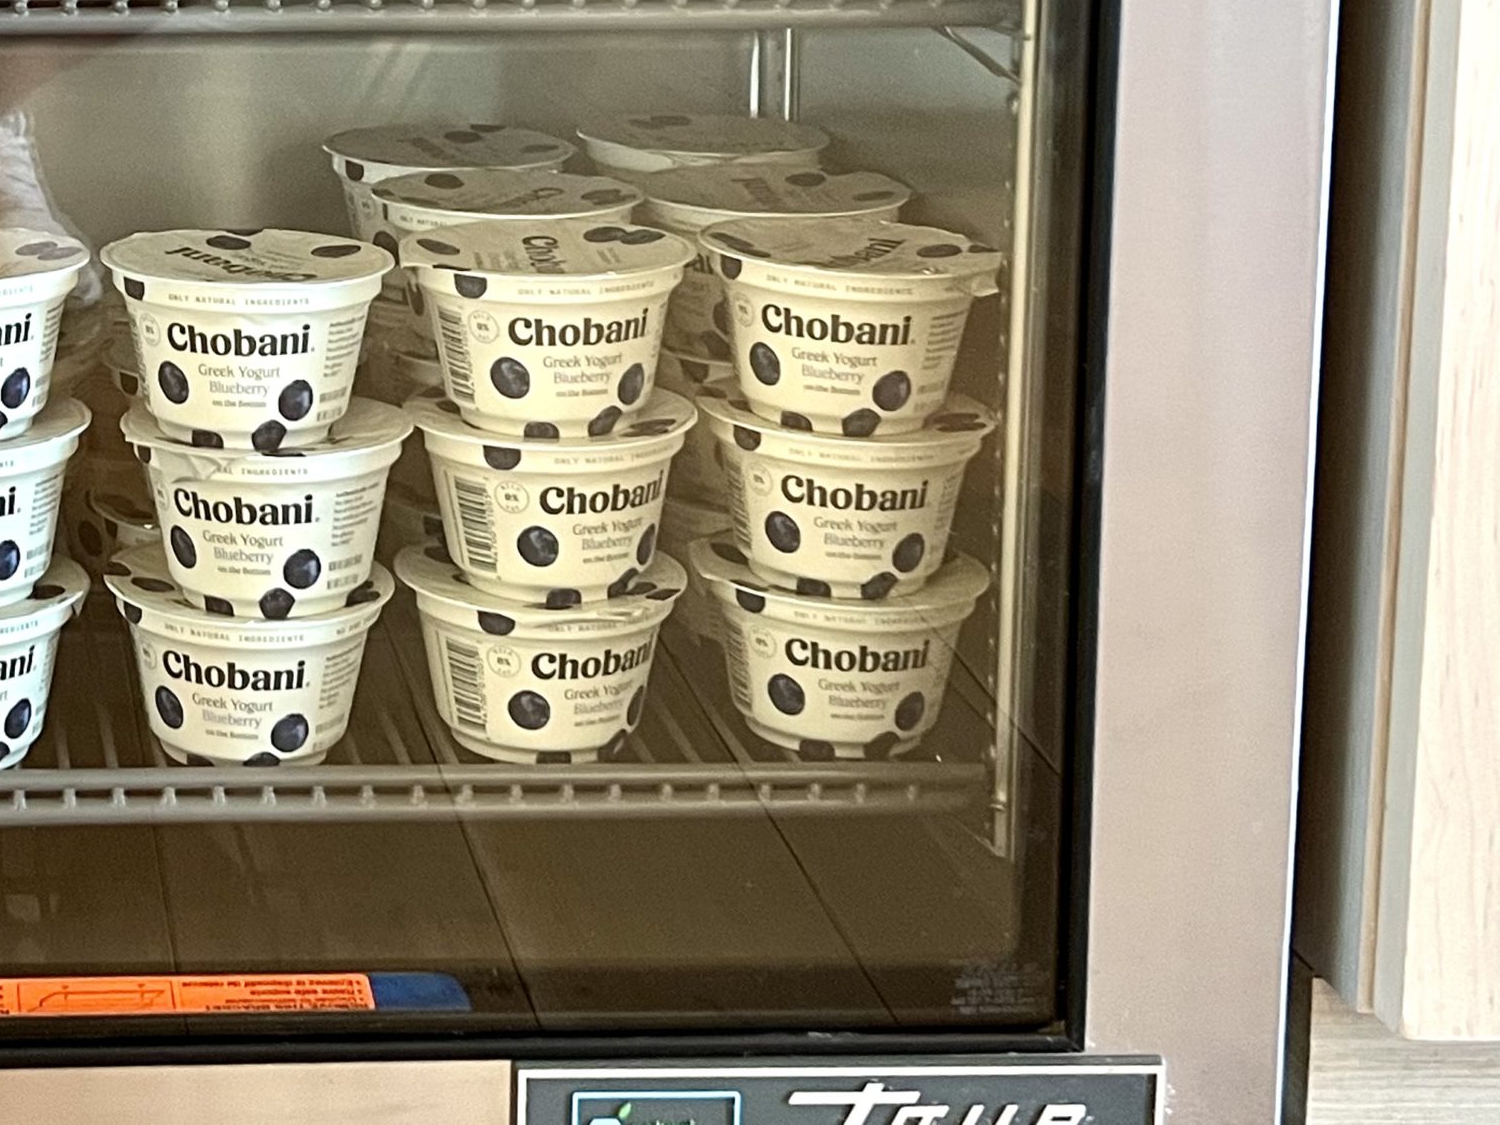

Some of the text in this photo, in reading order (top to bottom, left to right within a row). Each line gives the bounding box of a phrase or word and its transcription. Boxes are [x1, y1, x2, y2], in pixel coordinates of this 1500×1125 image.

[508, 308, 648, 346] Chobani
[762, 304, 912, 346] Chobani
[167, 323, 310, 356] Chobani
[543, 353, 623, 367] Greek Yogurt
[792, 347, 877, 367] Greek Yogurt
[198, 364, 280, 380] Greek Yogurt
[554, 371, 612, 384] Blueberry
[802, 364, 865, 382] Blueberry
[210, 382, 269, 396] Blueberry
[539, 469, 664, 514] Chobani
[781, 475, 928, 511] Chobani
[174, 488, 312, 525] Chobani
[573, 523, 609, 535] Greek
[203, 530, 284, 549] Greek Yogurt
[214, 547, 273, 563] Blueberry
[785, 638, 930, 673] Chobani
[163, 651, 306, 691] Chobani
[192, 693, 273, 713] Greek Yogurt
[202, 711, 262, 728] Blueberry
